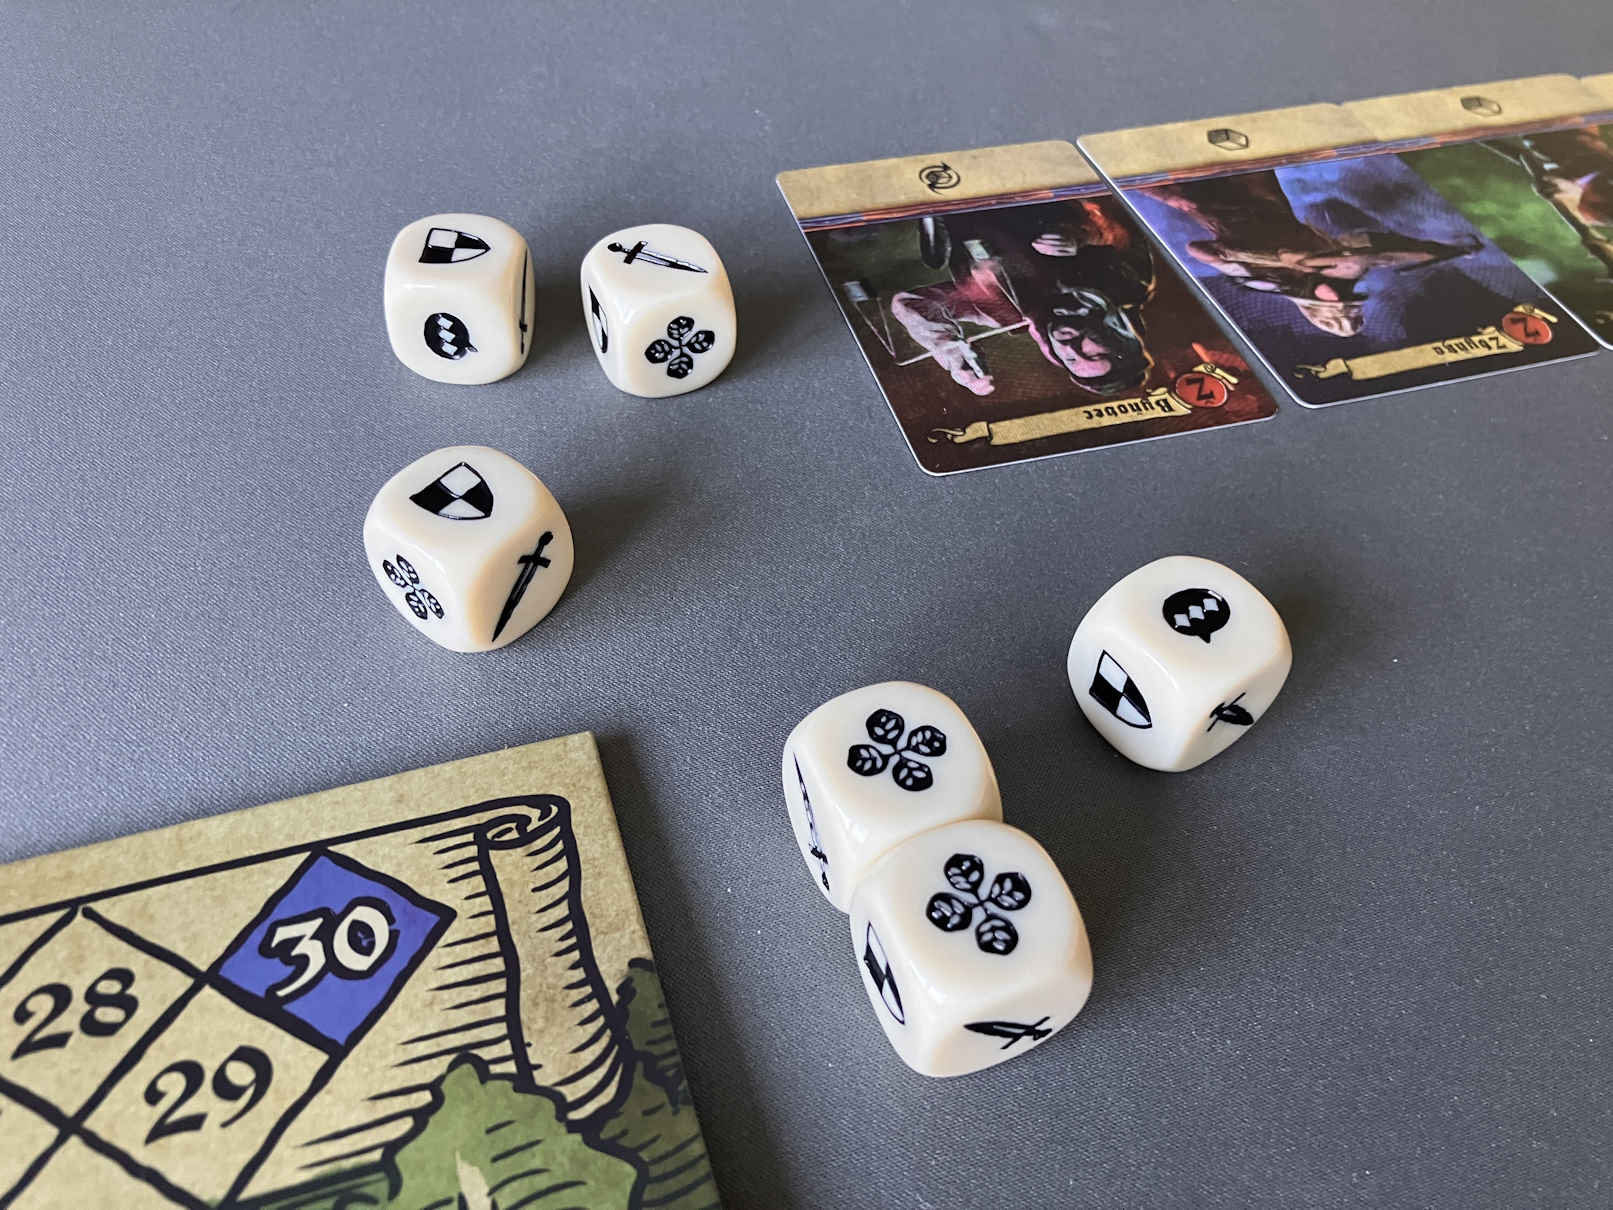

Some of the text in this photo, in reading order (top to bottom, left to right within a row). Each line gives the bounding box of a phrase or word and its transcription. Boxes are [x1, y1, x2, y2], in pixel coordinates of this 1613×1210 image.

[263, 898, 397, 1000] 30
[11, 967, 139, 1060] 28
[144, 1045, 273, 1146] 29
